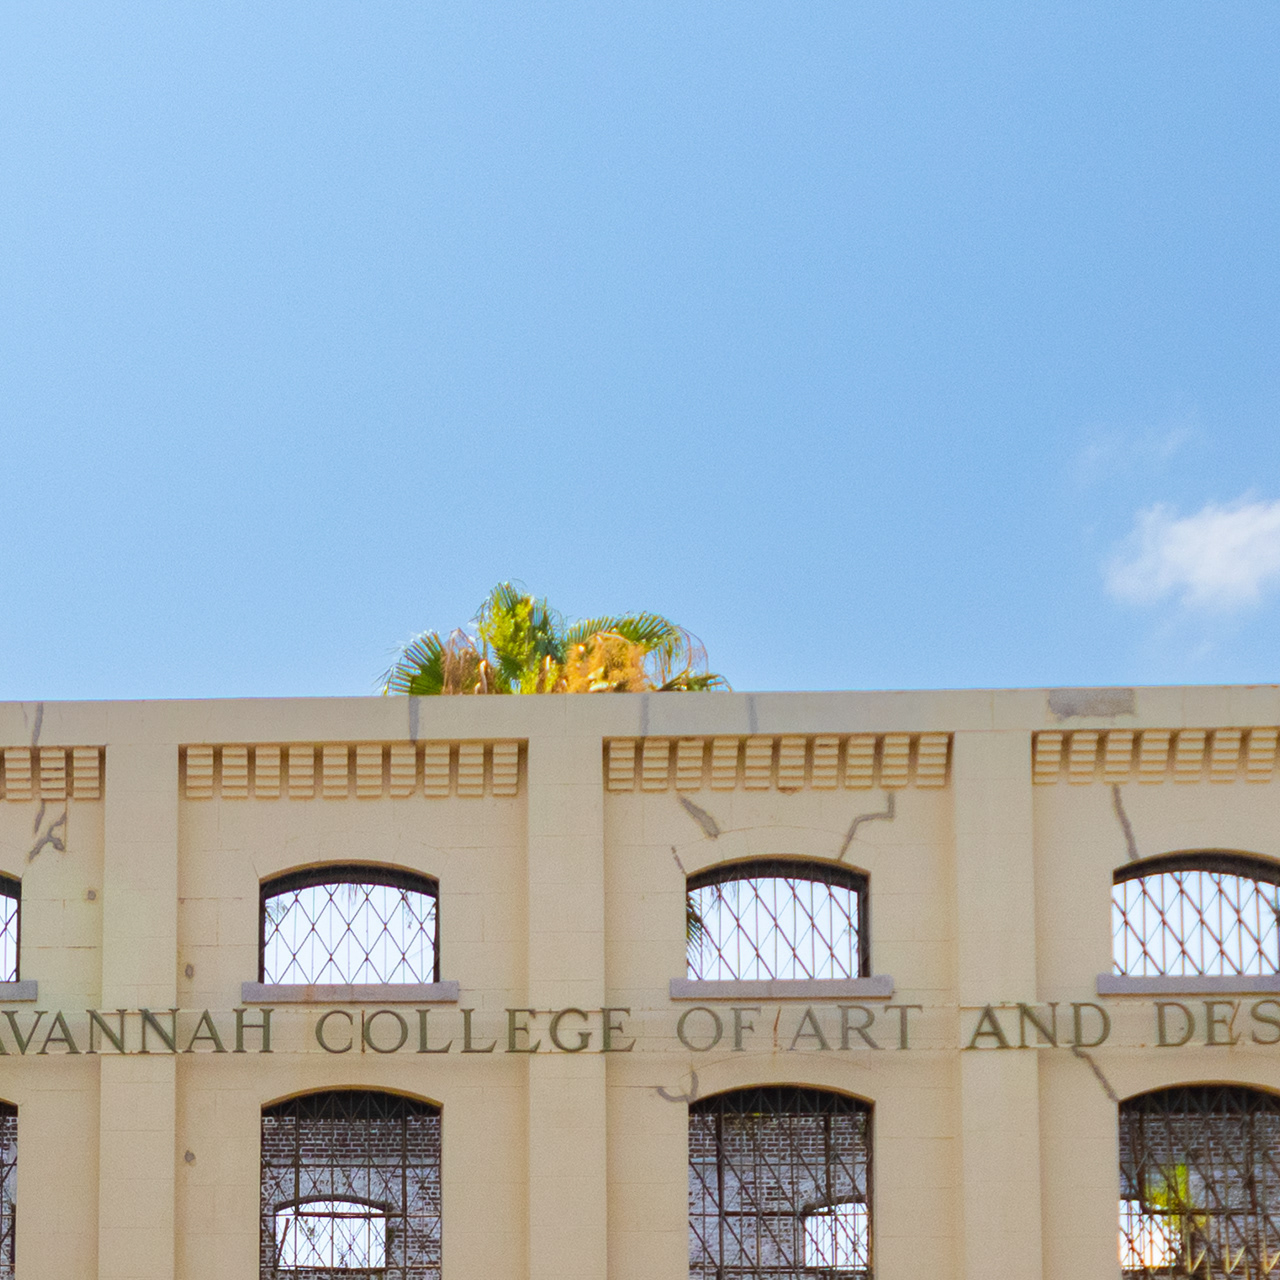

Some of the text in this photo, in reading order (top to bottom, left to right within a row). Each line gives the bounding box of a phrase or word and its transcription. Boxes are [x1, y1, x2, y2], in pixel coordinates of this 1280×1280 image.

[314, 1006, 638, 1054] COLLEGE
[676, 1005, 762, 1052] OF
[788, 1003, 924, 1052] ART
[964, 1002, 1112, 1050] AND
